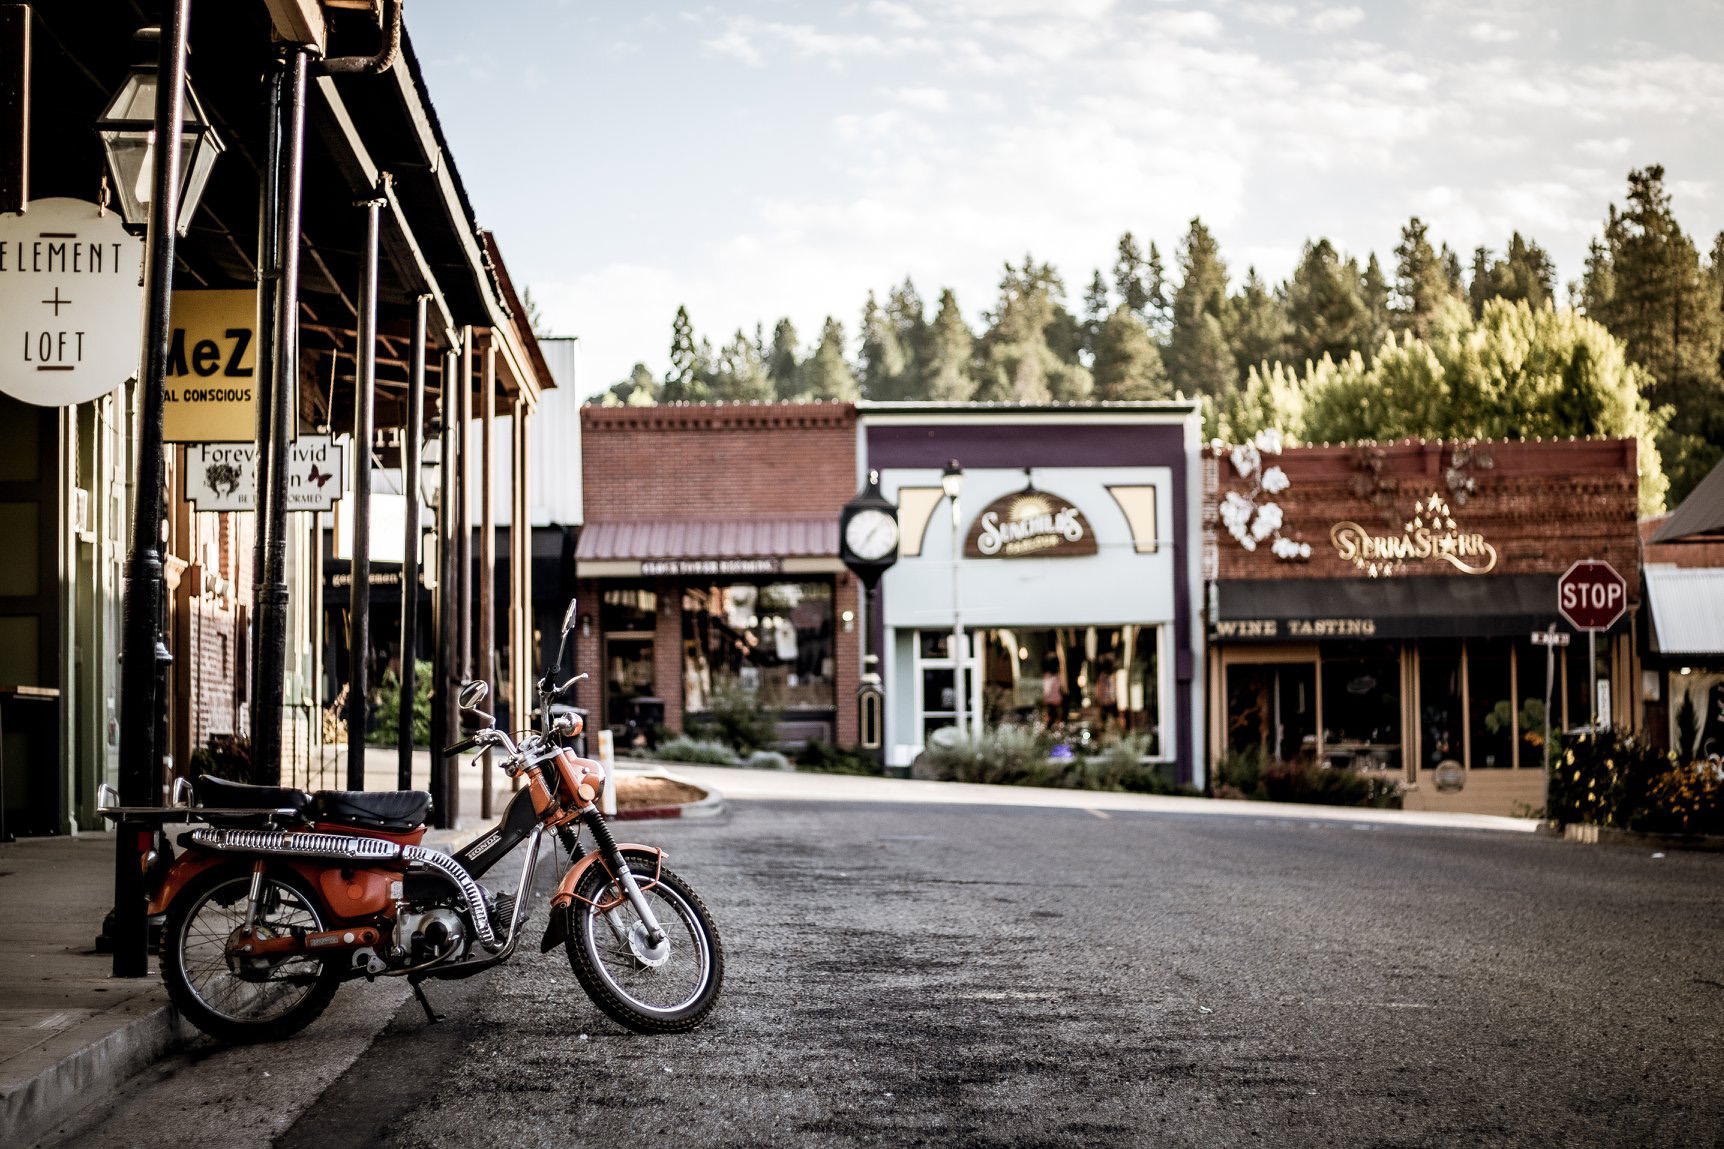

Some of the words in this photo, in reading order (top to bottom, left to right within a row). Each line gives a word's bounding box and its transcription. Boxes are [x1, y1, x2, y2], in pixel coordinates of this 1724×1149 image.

[0, 241, 121, 273] ELEMENT
[24, 331, 85, 362] LOFT
[164, 389, 179, 401] AL
[183, 388, 251, 401] CONSCIOUS
[202, 443, 259, 463] Forev
[293, 444, 326, 462] ivid
[1563, 583, 1622, 609] STOP
[1216, 619, 1277, 637] WINE
[1288, 618, 1376, 636] TASTING
[467, 834, 500, 859] HONDA
